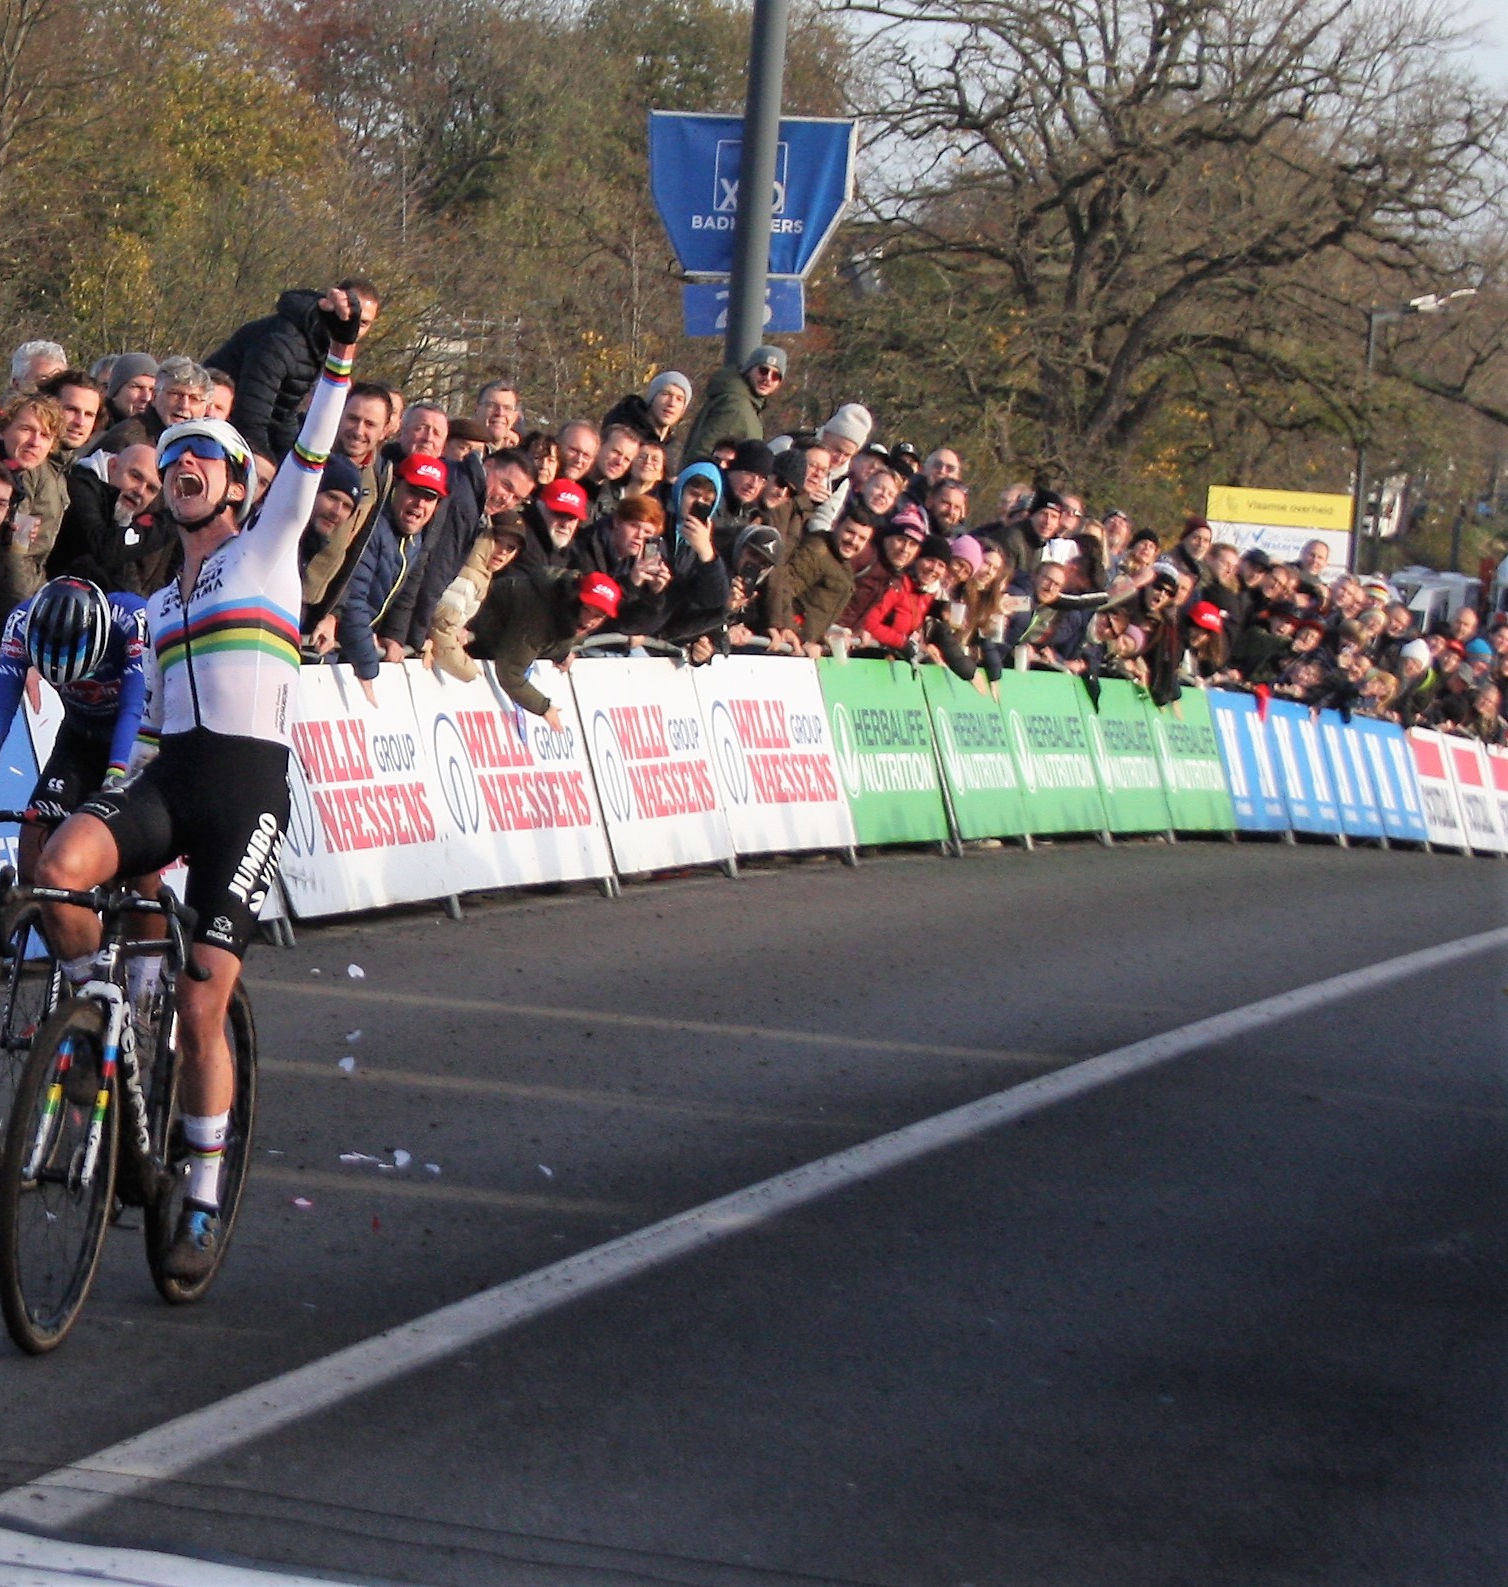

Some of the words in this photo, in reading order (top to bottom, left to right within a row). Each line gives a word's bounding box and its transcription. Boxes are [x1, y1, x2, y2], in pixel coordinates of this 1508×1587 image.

[692, 214, 804, 234] BADERS
[534, 725, 574, 760] GROUP
[608, 705, 670, 760] WILLY
[668, 717, 699, 751] GROUP
[728, 699, 791, 748] WILLY
[790, 714, 822, 744] GROUP
[852, 709, 927, 746] HERBALIFE
[292, 719, 374, 784] WILLY
[373, 733, 416, 772] GROUP
[859, 752, 935, 792] NUTRITION
[478, 770, 592, 832] NAESSENS
[627, 759, 716, 819] NAESSENS
[747, 753, 838, 804] NAESSENS
[312, 782, 436, 853] NAESSENS
[228, 812, 277, 903] JUMBO
